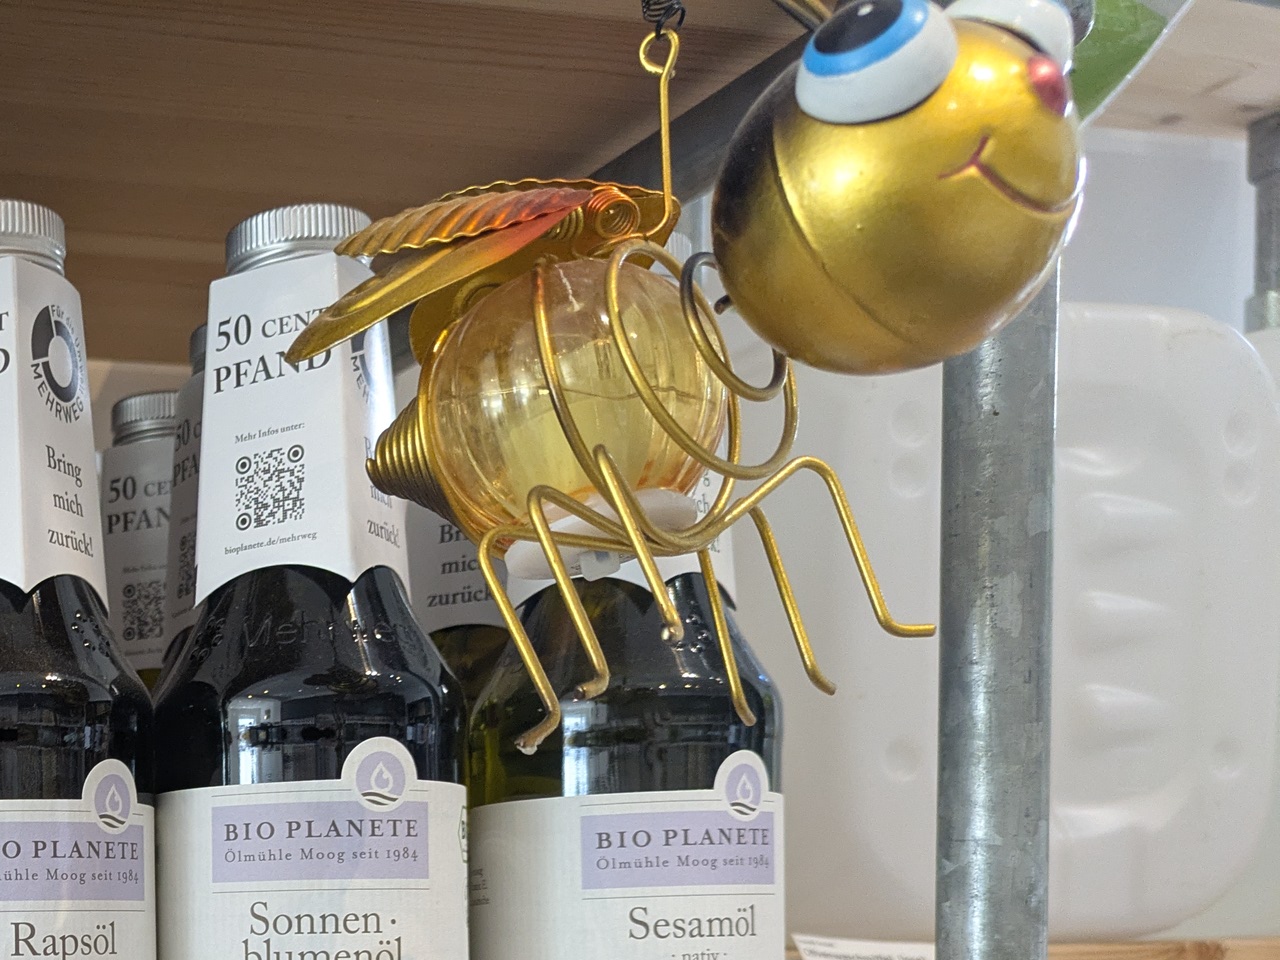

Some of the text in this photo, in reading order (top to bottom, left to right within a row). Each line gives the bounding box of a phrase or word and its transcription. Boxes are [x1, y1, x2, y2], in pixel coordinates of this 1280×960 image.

[31, 362, 84, 423] MEHRWEG
[235, 422, 305, 444] Mehr Infos unter:
[45, 445, 82, 487] Bring
[53, 490, 83, 518] mich
[48, 527, 93, 558] zurück!
[224, 531, 317, 556] bioplanete.de/mehrweg
[32, 841, 139, 860] PLANETE
[629, 905, 756, 940] Sesamöl
